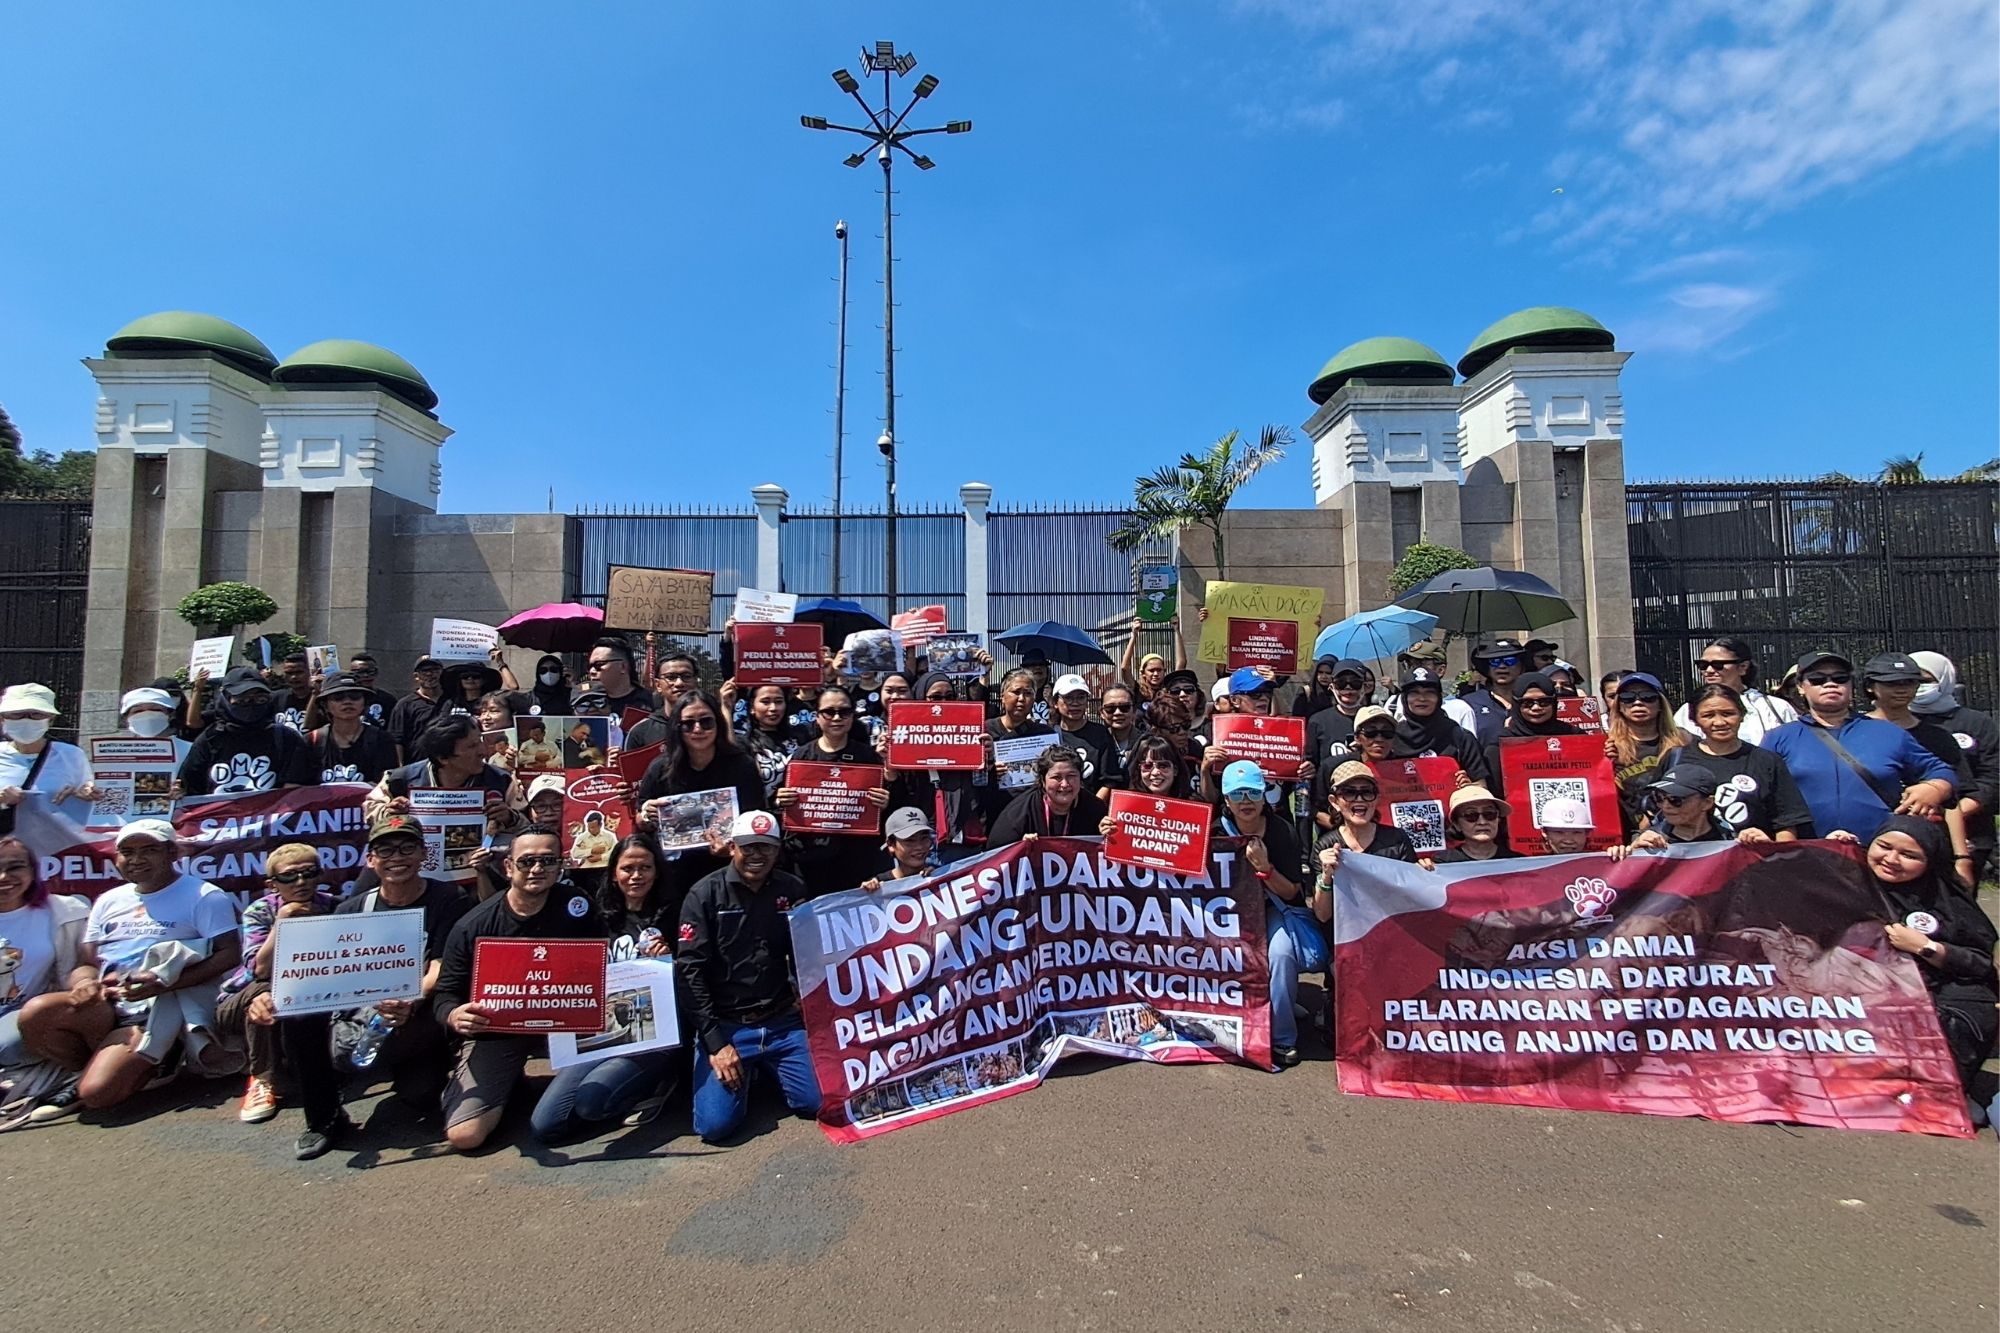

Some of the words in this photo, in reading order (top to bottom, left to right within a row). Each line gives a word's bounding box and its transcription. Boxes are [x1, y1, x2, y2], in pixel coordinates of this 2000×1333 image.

[619, 574, 664, 594] SAYA
[623, 596, 663, 609] TIDAK
[1213, 593, 1270, 613] MAKAN
[771, 642, 789, 650] AKU
[1251, 647, 1294, 655] PERDAGANGAN
[743, 651, 774, 659] PEDULI
[775, 651, 782, 659] &
[740, 661, 772, 670] ANJING
[774, 661, 820, 669] INDONESIA
[909, 725, 930, 733] DOG
[932, 725, 957, 733] MEAT
[960, 725, 981, 733] FREE
[909, 734, 981, 745] INDONESIA
[1228, 732, 1264, 741] INDONESIA
[1264, 735, 1290, 743] SEGERA
[1249, 742, 1298, 752] PERDAGANGAN
[1275, 753, 1301, 761] KUCING
[215, 756, 275, 790] DMFI
[820, 781, 848, 789] SUARA
[813, 788, 847, 796] BERSATU
[807, 795, 858, 805] MELINDUNGI
[799, 803, 835, 812] HAK-HAK
[814, 812, 859, 820] INDONESIA!
[200, 814, 265, 842] SAH
[1116, 811, 1158, 828] KORSEL
[1160, 818, 1201, 835] SUDAH
[1124, 824, 1190, 845] INDONESIA
[1131, 838, 1179, 854] KAPAN?
[817, 856, 1037, 955] INDONESIA
[121, 920, 177, 928] SINGAPORE
[124, 928, 167, 936] AIRLINES
[337, 933, 363, 944] AKU
[292, 951, 338, 963] PEDULI
[341, 949, 351, 958] &
[354, 944, 406, 957] SAYANG
[825, 893, 1240, 1007] UNDANG-UNDANG
[1506, 940, 1578, 961] AKSI
[1586, 935, 1696, 958] DAMAI
[281, 966, 330, 980] ANJING
[333, 963, 362, 974] DAN
[365, 958, 416, 972] KUCING
[525, 970, 552, 981] AKU
[1438, 967, 1613, 990] INDONESIA
[1620, 964, 1777, 988] DARURAT
[483, 984, 526, 995] PEDULI
[529, 984, 540, 995] &
[542, 984, 593, 995] SAYANG
[834, 954, 1032, 1050] PELARANGAN
[1031, 937, 1244, 975] PERDAGANGAN
[479, 998, 524, 1012] ANJING
[527, 998, 598, 1009] INDONESIA
[1384, 999, 1593, 1021] PELARANGAN
[1601, 996, 1867, 1021] PERDAGANGAN
[842, 1019, 957, 1092] DAGING
[963, 977, 1055, 1041] ANJING
[1057, 969, 1119, 1002] DAN
[1123, 969, 1244, 1007] KUCING
[1385, 1030, 1505, 1053] DAGING
[1515, 1030, 1638, 1053] ANJING
[1646, 1028, 1718, 1052] DAN
[1723, 1028, 1877, 1054] KUCING
